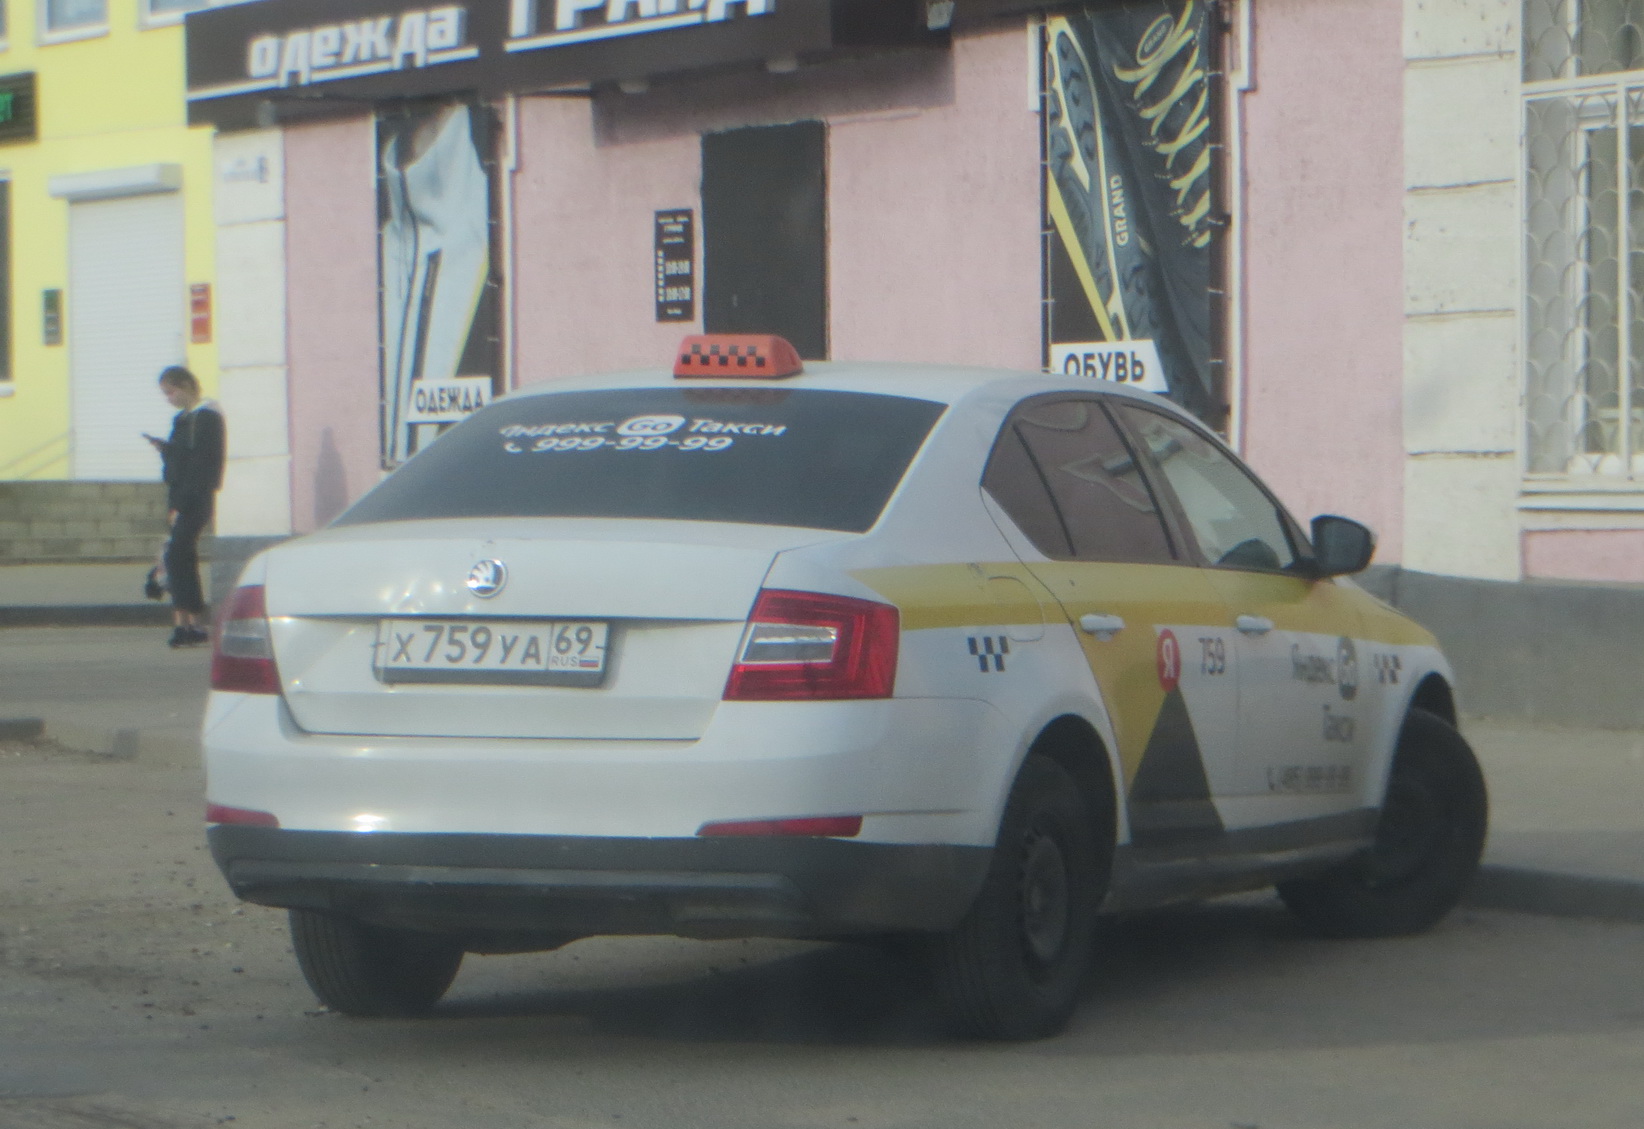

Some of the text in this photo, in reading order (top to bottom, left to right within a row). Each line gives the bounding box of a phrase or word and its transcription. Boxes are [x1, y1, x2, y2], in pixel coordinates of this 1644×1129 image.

[248, 6, 463, 88] одежда
[1110, 174, 1129, 248] GRAND
[1063, 350, 1145, 382] ОБУВЬ
[415, 386, 484, 414] ОДЕЖДА
[690, 417, 788, 436] Такси
[531, 437, 734, 451] 999-99-99
[555, 625, 593, 656] 69
[1198, 637, 1225, 674] 759
[551, 656, 578, 668] RUS
